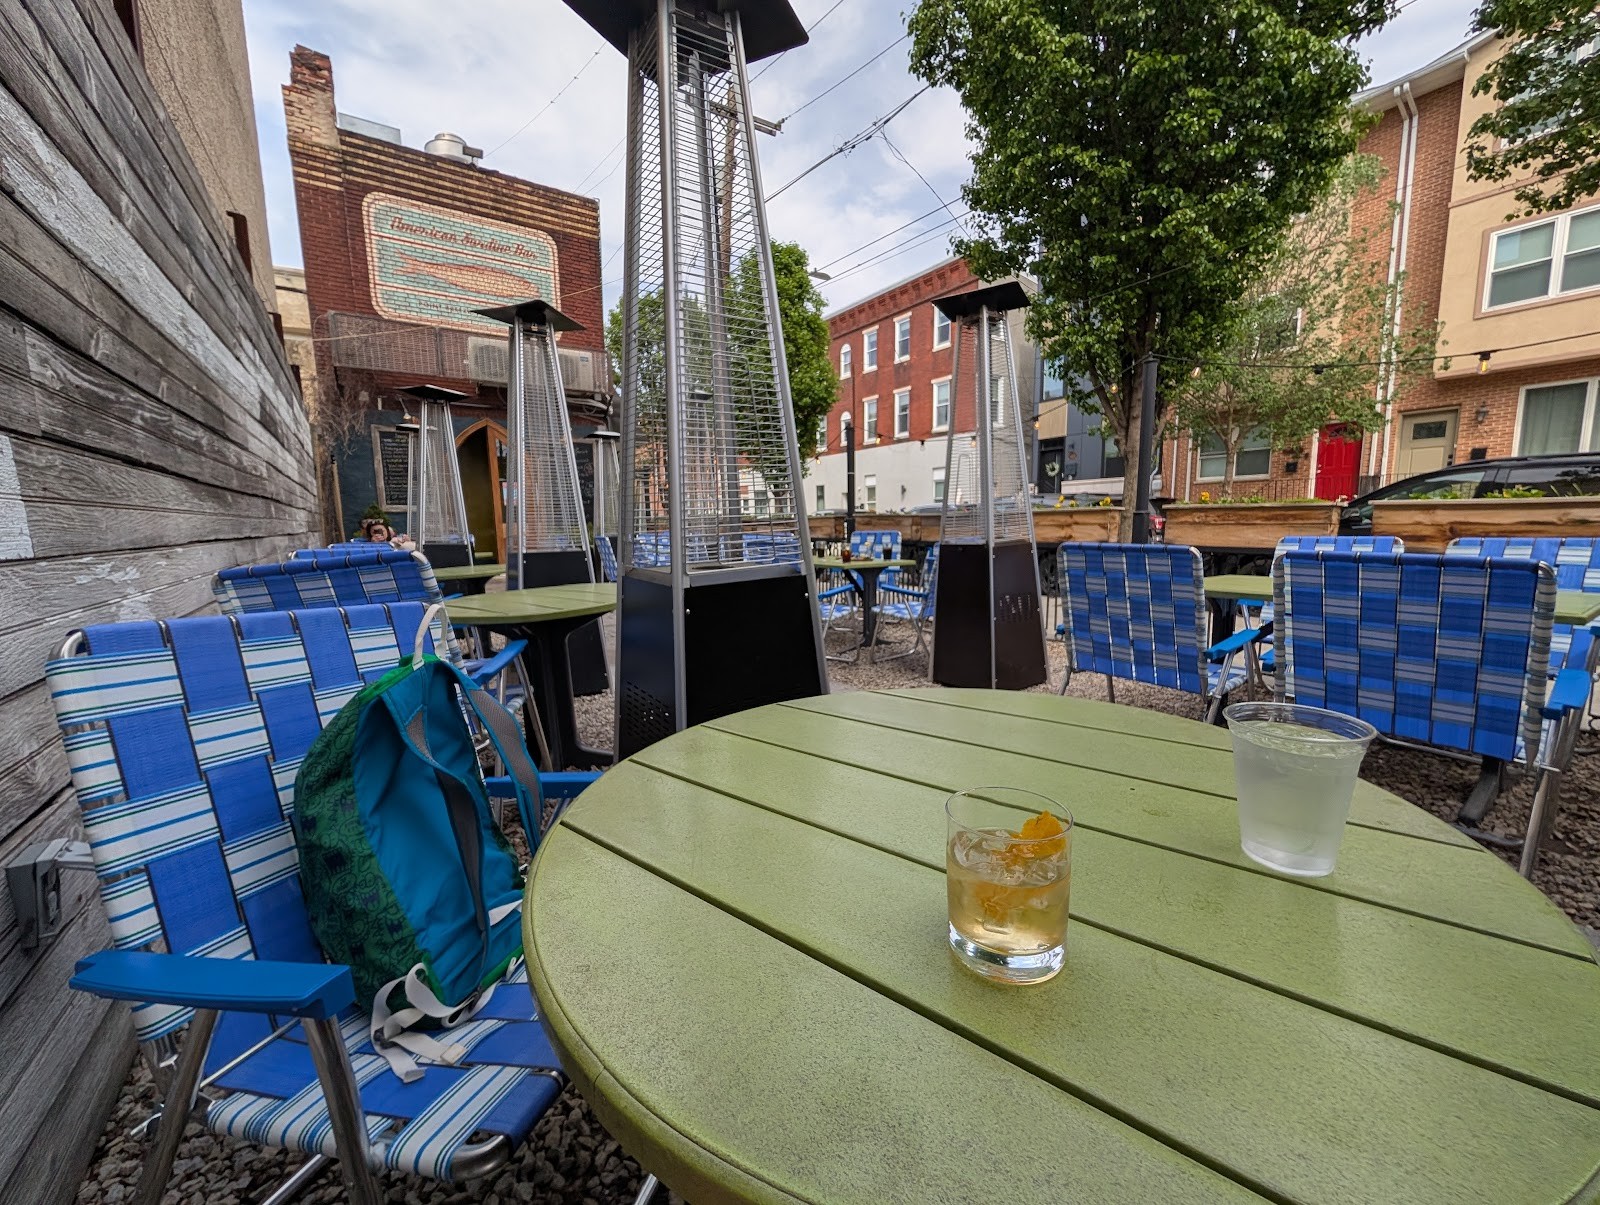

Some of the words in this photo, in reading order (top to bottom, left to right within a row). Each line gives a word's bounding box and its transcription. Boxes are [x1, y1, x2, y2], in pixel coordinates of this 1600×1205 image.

[390, 216, 457, 242] American
[462, 231, 512, 254] Sardine
[513, 242, 538, 260] Bar
